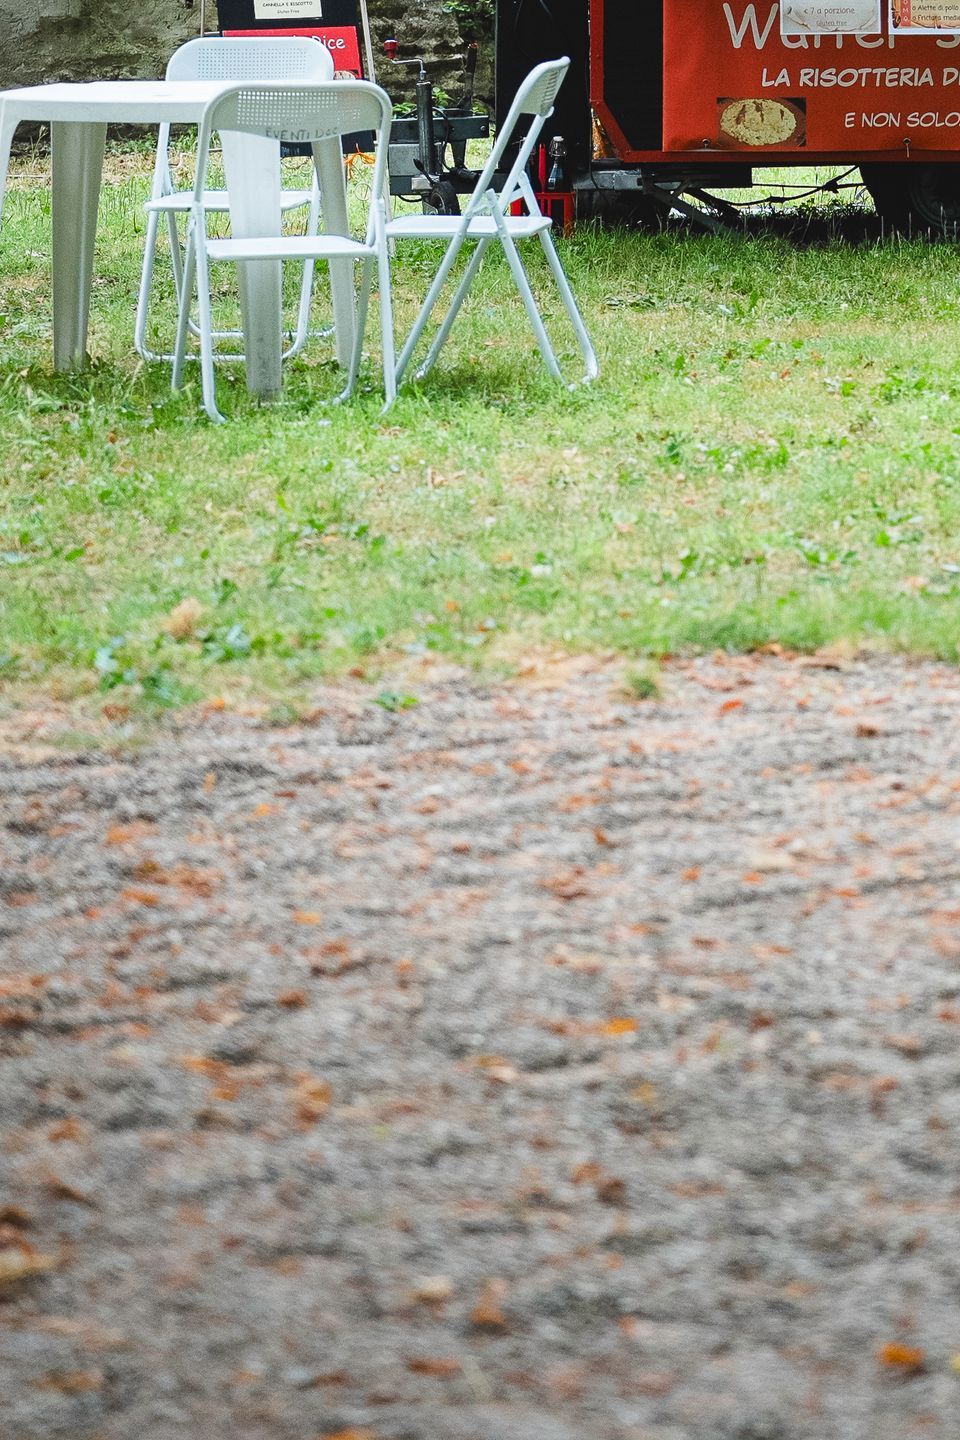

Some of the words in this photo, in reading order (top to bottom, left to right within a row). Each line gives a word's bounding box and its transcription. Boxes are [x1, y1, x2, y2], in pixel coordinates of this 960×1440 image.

[824, 7, 856, 17] porzione
[945, 4, 960, 13] pollo
[761, 68, 791, 87] LA
[799, 67, 934, 87] RISOTTERIA
[845, 113, 854, 128] E
[861, 113, 900, 128] NON
